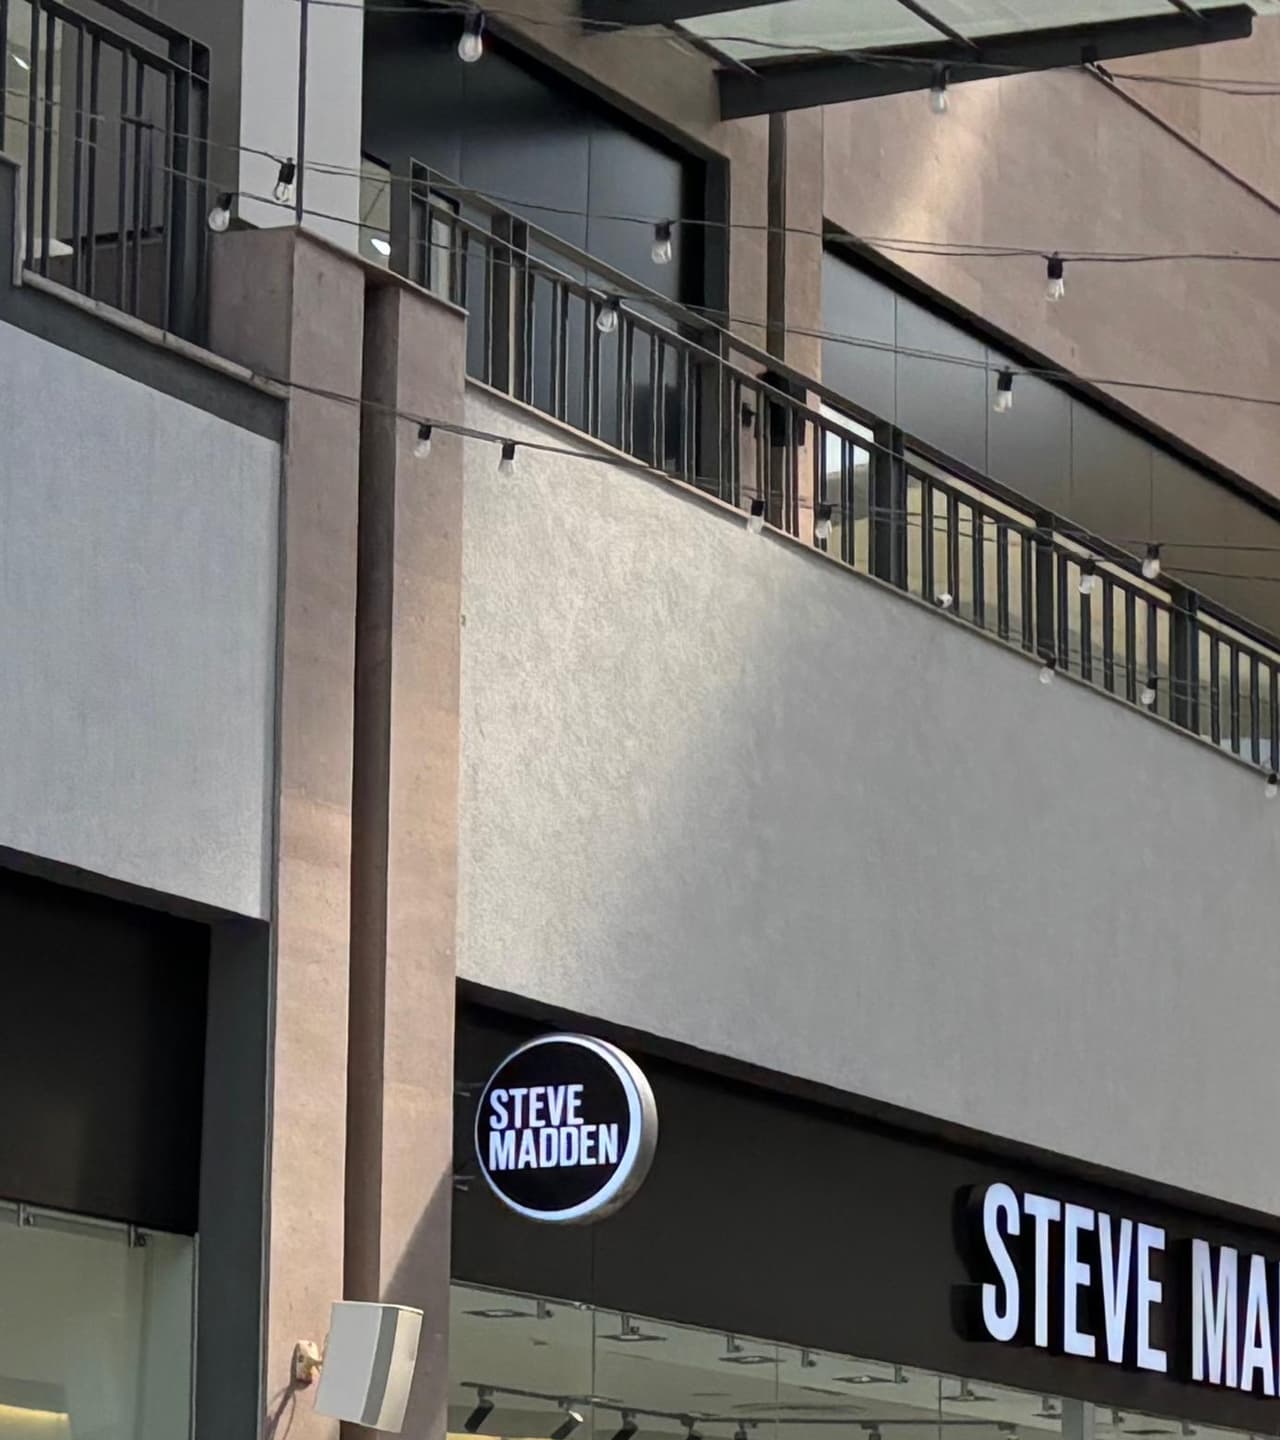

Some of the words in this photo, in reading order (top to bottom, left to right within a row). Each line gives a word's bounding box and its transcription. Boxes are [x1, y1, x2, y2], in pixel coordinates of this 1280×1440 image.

[489, 1084, 584, 1130] STEVE
[488, 1123, 618, 1171] MADDEN
[982, 1183, 1168, 1373] STEVE
